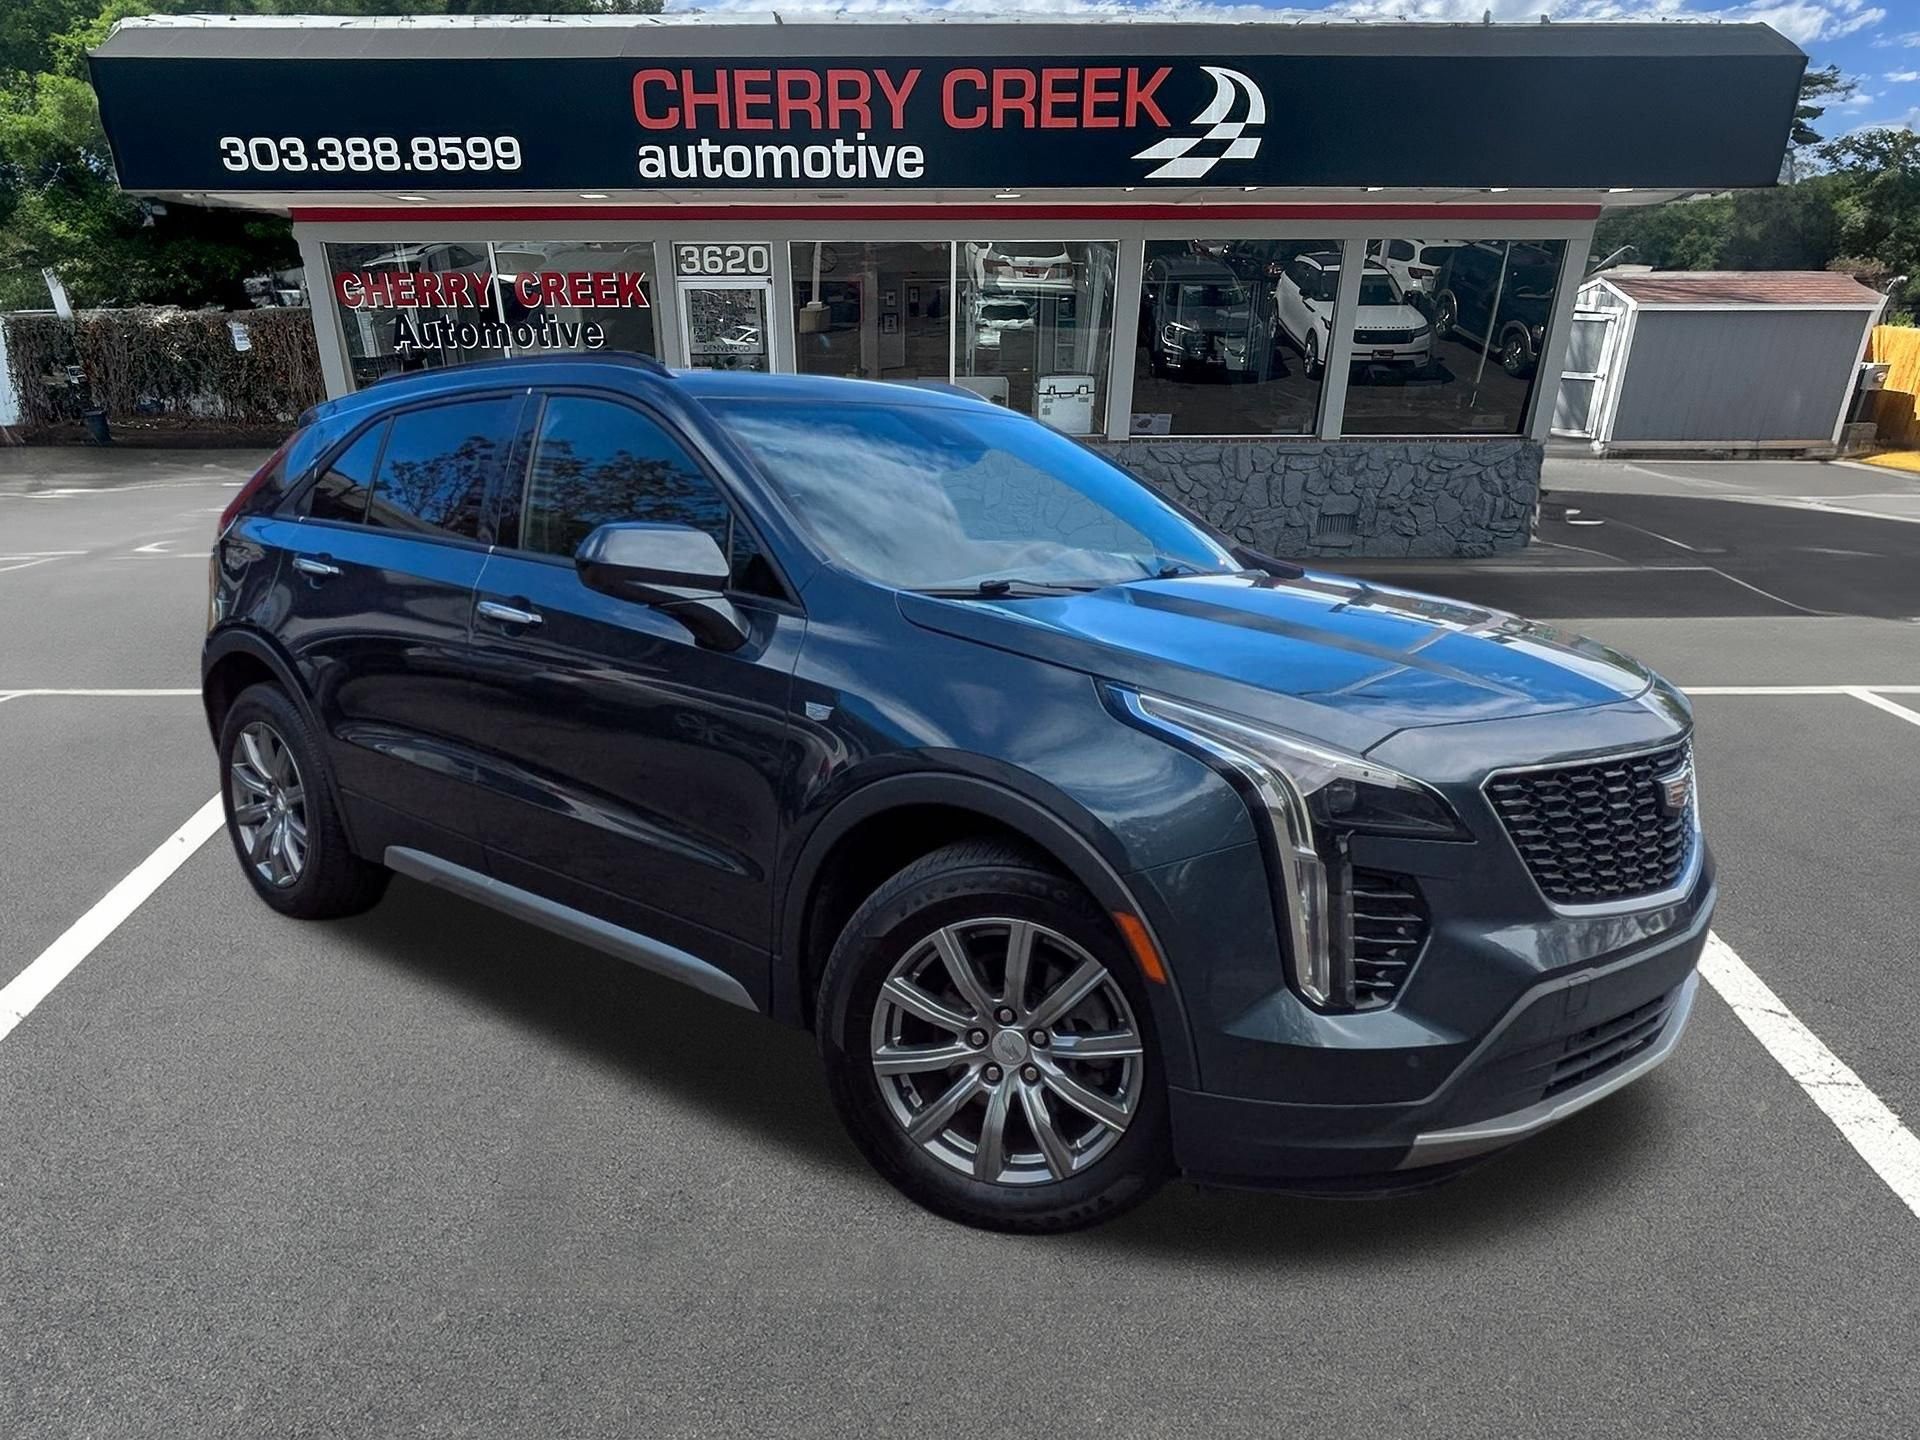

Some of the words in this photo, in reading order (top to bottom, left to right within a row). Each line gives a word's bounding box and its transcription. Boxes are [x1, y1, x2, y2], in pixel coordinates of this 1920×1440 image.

[633, 69, 918, 131] CHERRY
[942, 66, 1170, 130] CREEK
[219, 135, 522, 173] 303.388.8599
[638, 133, 924, 180] automotive
[680, 245, 769, 274] 3620
[334, 271, 494, 309] CHERRY
[515, 271, 650, 308] CREEK
[393, 313, 606, 350] Automotive
